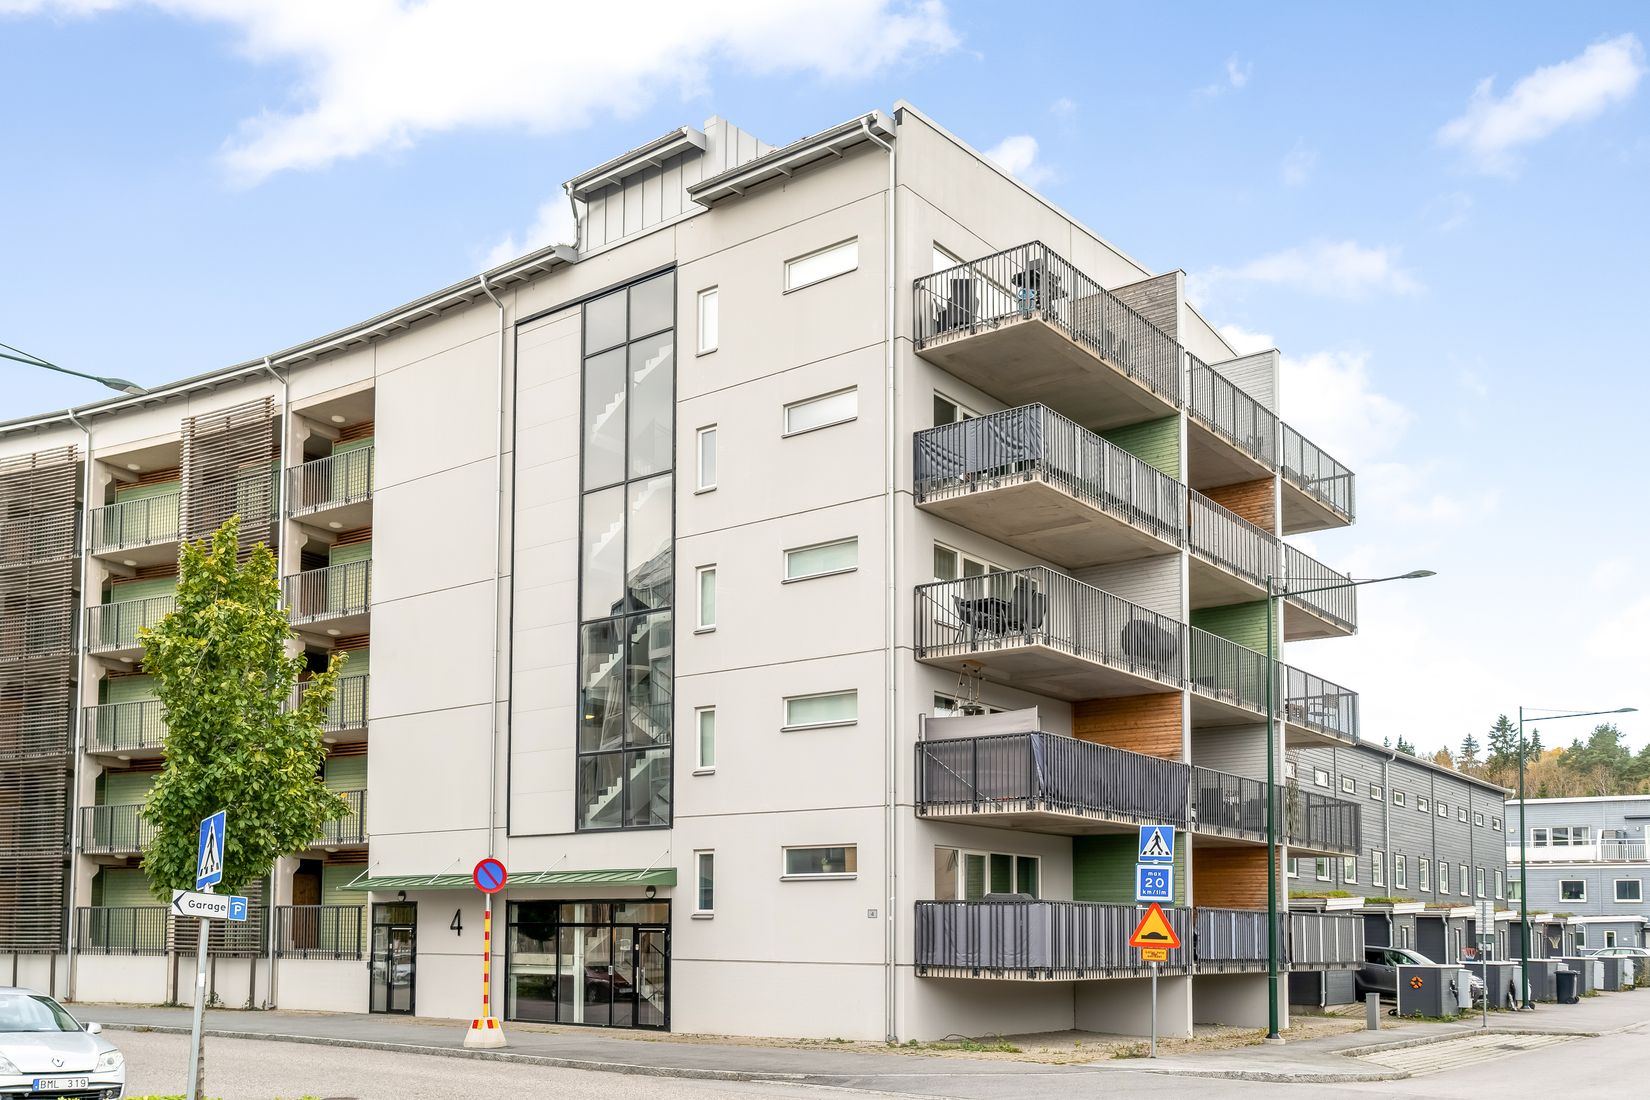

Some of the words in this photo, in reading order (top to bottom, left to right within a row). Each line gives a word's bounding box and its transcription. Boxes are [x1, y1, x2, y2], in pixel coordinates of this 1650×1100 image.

[1145, 877, 1165, 888] 20
[188, 899, 227, 913] Garage
[234, 904, 242, 915] P
[450, 908, 463, 937] 4
[40, 1080, 60, 1089] BML
[67, 1079, 86, 1088] 319
